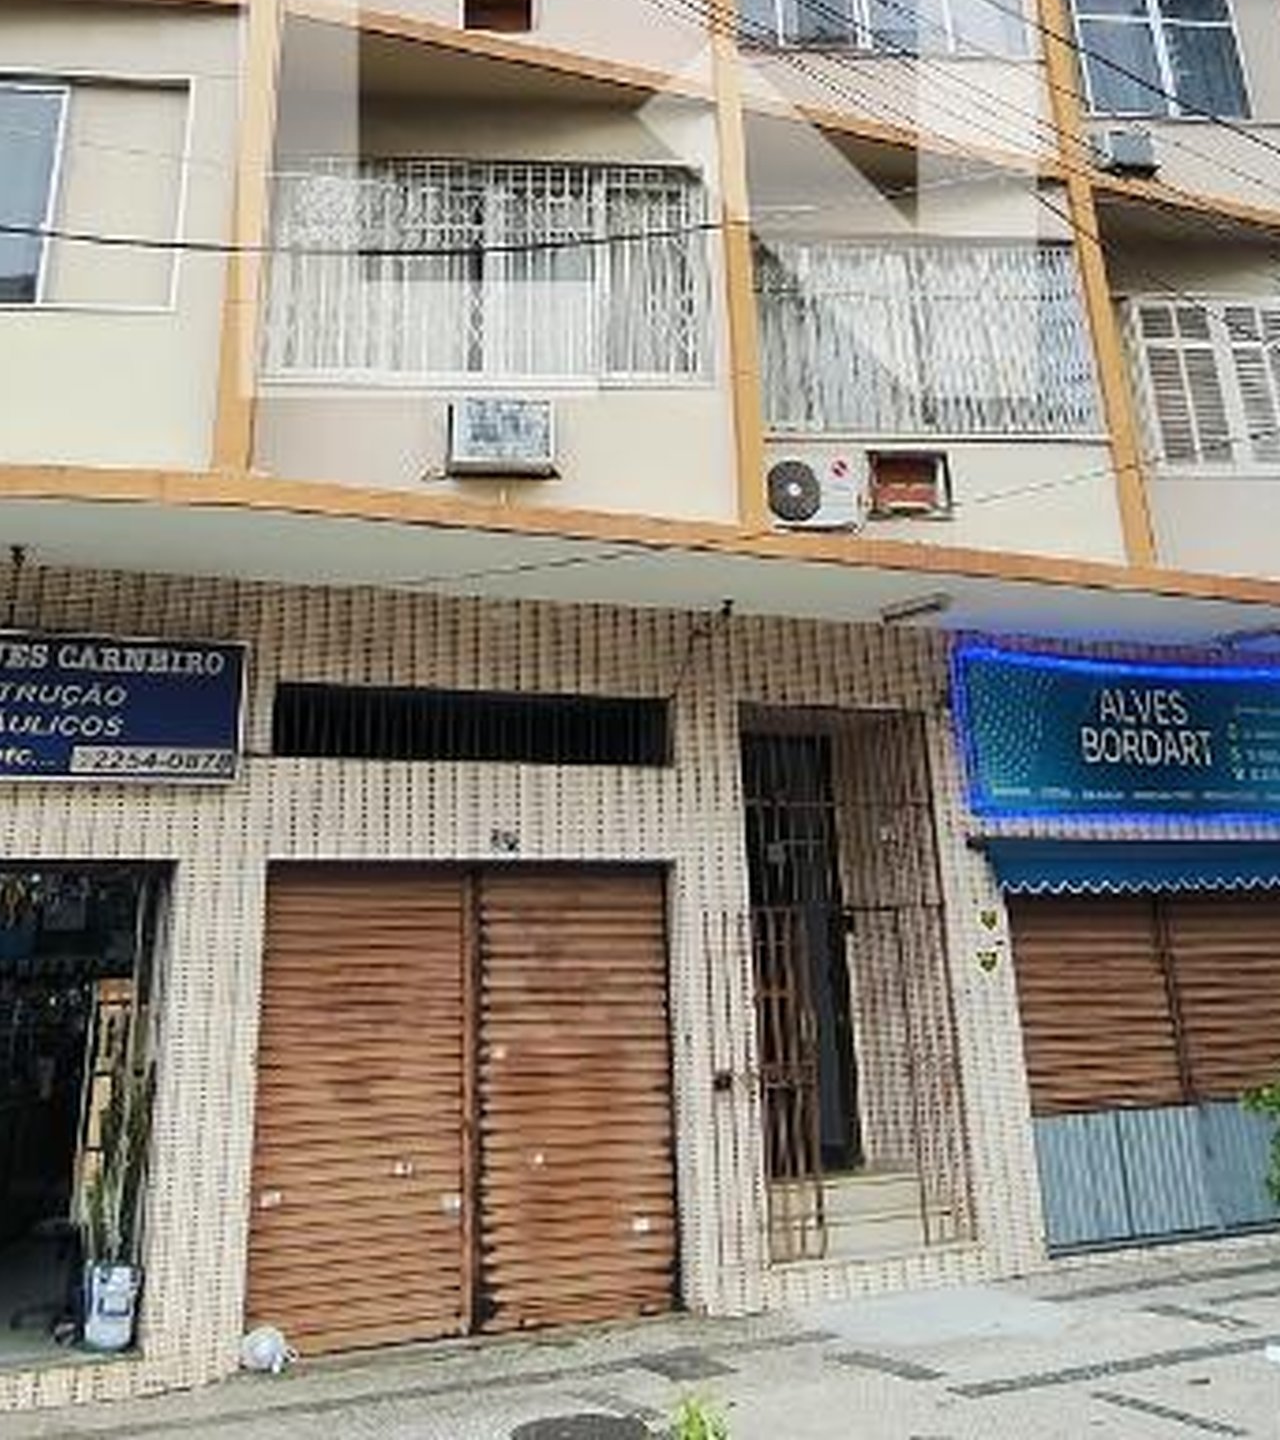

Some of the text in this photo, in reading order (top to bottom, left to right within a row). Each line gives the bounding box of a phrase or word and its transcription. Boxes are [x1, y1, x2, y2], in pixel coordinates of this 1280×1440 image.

[58, 644, 225, 675] CARNEIRO
[1100, 689, 1189, 725] ALVES
[1081, 726, 1212, 766] BORDART
